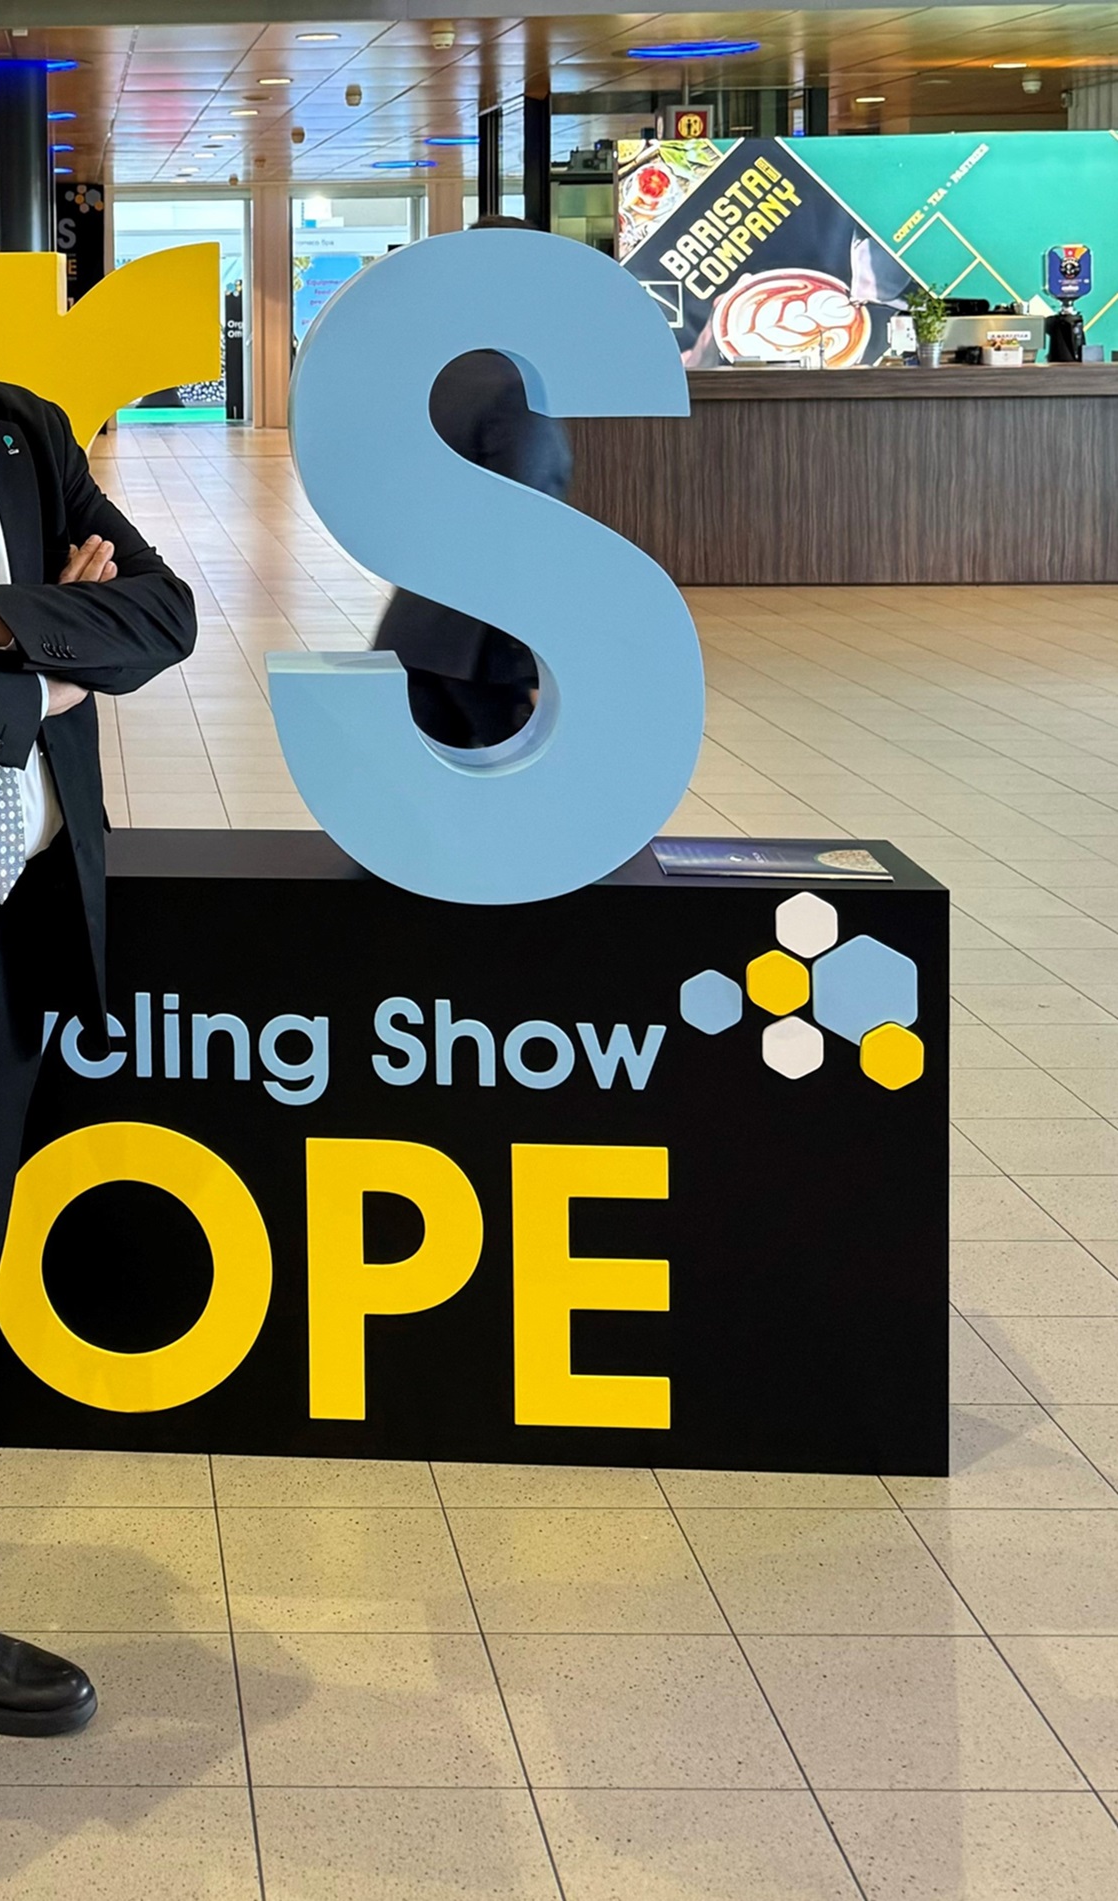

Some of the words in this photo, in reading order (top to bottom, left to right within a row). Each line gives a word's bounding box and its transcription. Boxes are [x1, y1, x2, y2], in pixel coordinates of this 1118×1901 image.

[658, 168, 772, 280] BARISTA
[684, 178, 803, 300] COMPANY
[926, 187, 948, 206] TEA
[372, 997, 667, 1090] Show
